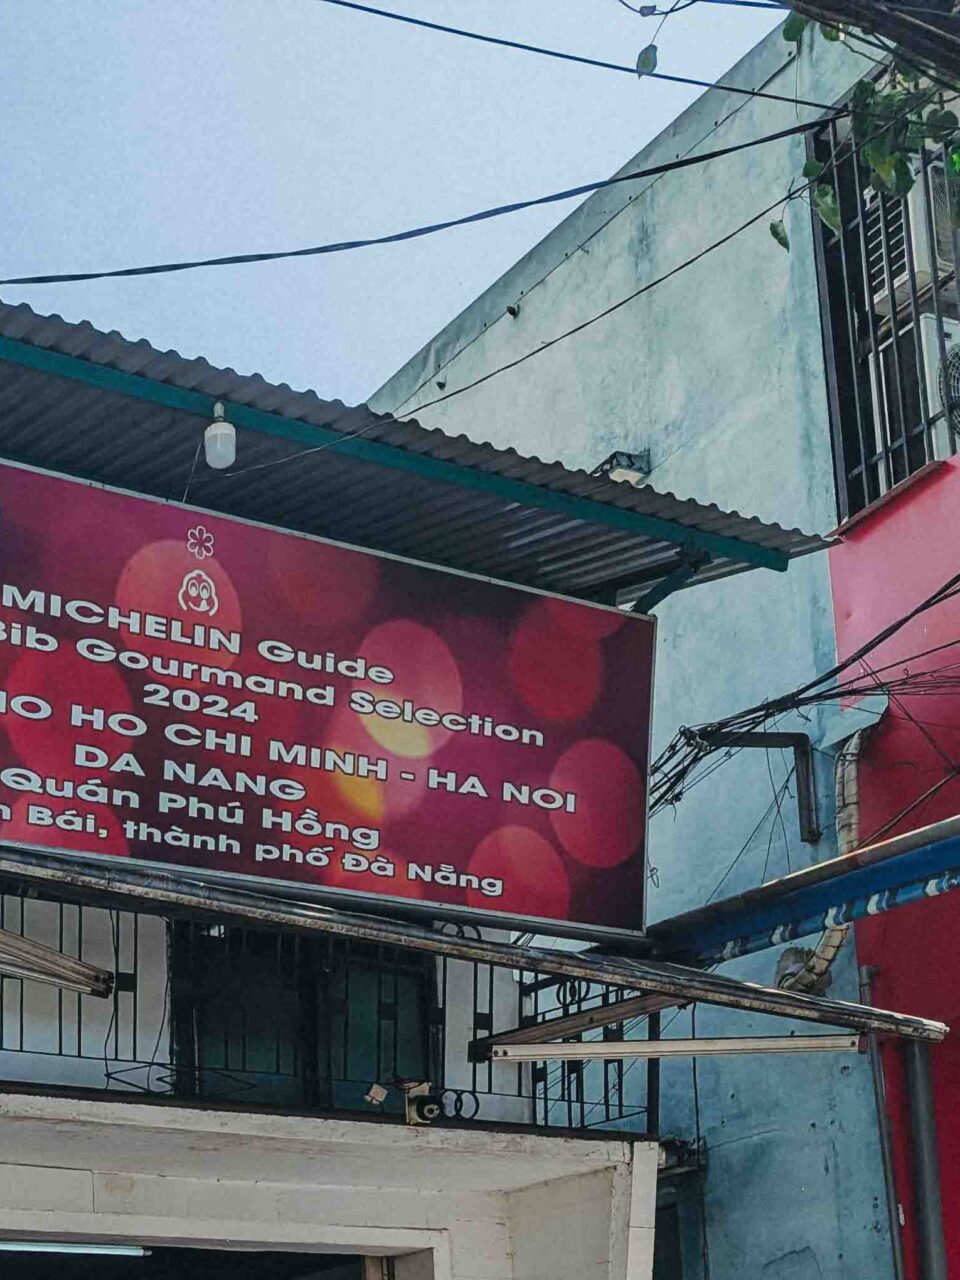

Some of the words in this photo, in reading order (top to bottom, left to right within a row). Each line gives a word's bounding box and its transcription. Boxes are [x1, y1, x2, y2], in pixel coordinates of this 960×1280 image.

[2, 583, 240, 654] MICHELIN
[257, 639, 395, 685] Guide
[75, 638, 335, 707] Gourmand
[350, 690, 544, 747] Selection
[142, 683, 259, 723] 2024
[71, 704, 148, 737] HO
[164, 723, 252, 758] CHI
[269, 740, 388, 781] MINH
[427, 768, 489, 798] HA
[502, 786, 577, 814] NOI
[74, 744, 146, 778] DA
[163, 759, 306, 801] NANG
[0, 767, 140, 809] Quán
[158, 790, 244, 826] Phú
[262, 808, 381, 851] Hồng
[28, 802, 109, 840] Bái,
[123, 820, 241, 855] thành
[255, 840, 334, 868] phố
[342, 849, 395, 878] Đà
[407, 863, 504, 898] Nẵng
